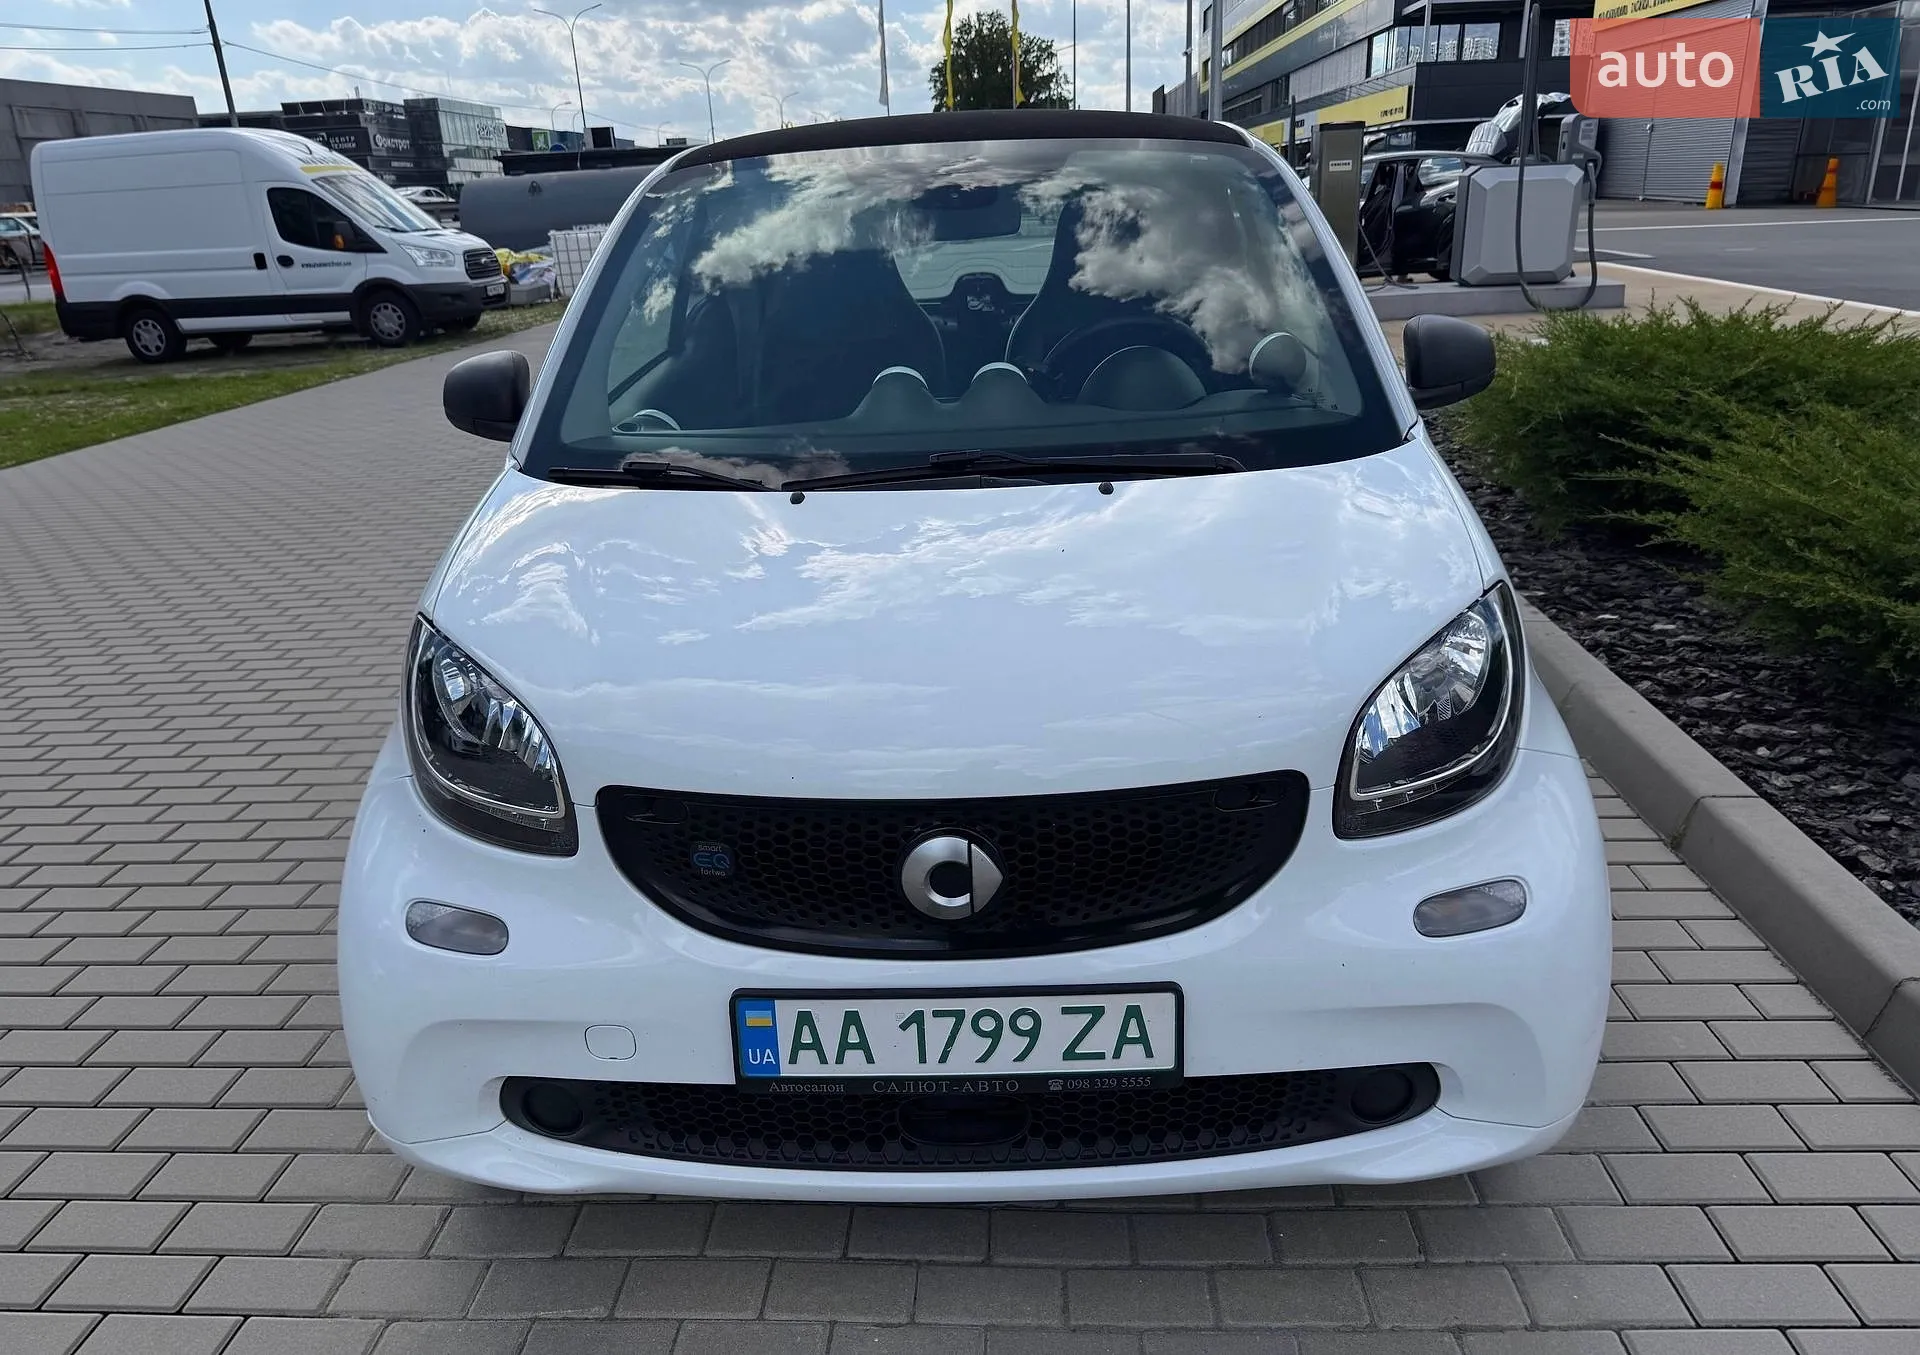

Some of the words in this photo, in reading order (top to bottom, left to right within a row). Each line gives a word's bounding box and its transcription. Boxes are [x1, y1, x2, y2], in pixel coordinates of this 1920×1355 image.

[788, 1010, 876, 1065] AA
[898, 1007, 1042, 1064] 1799
[1061, 1004, 1154, 1061] ZA
[748, 1048, 776, 1065] UA
[769, 1081, 845, 1093] Автосалон
[872, 1079, 1019, 1094] САЛЮТ-АВТО
[1067, 1078, 1090, 1090] 098
[1094, 1077, 1117, 1089] 329
[1120, 1075, 1152, 1088] 5555
